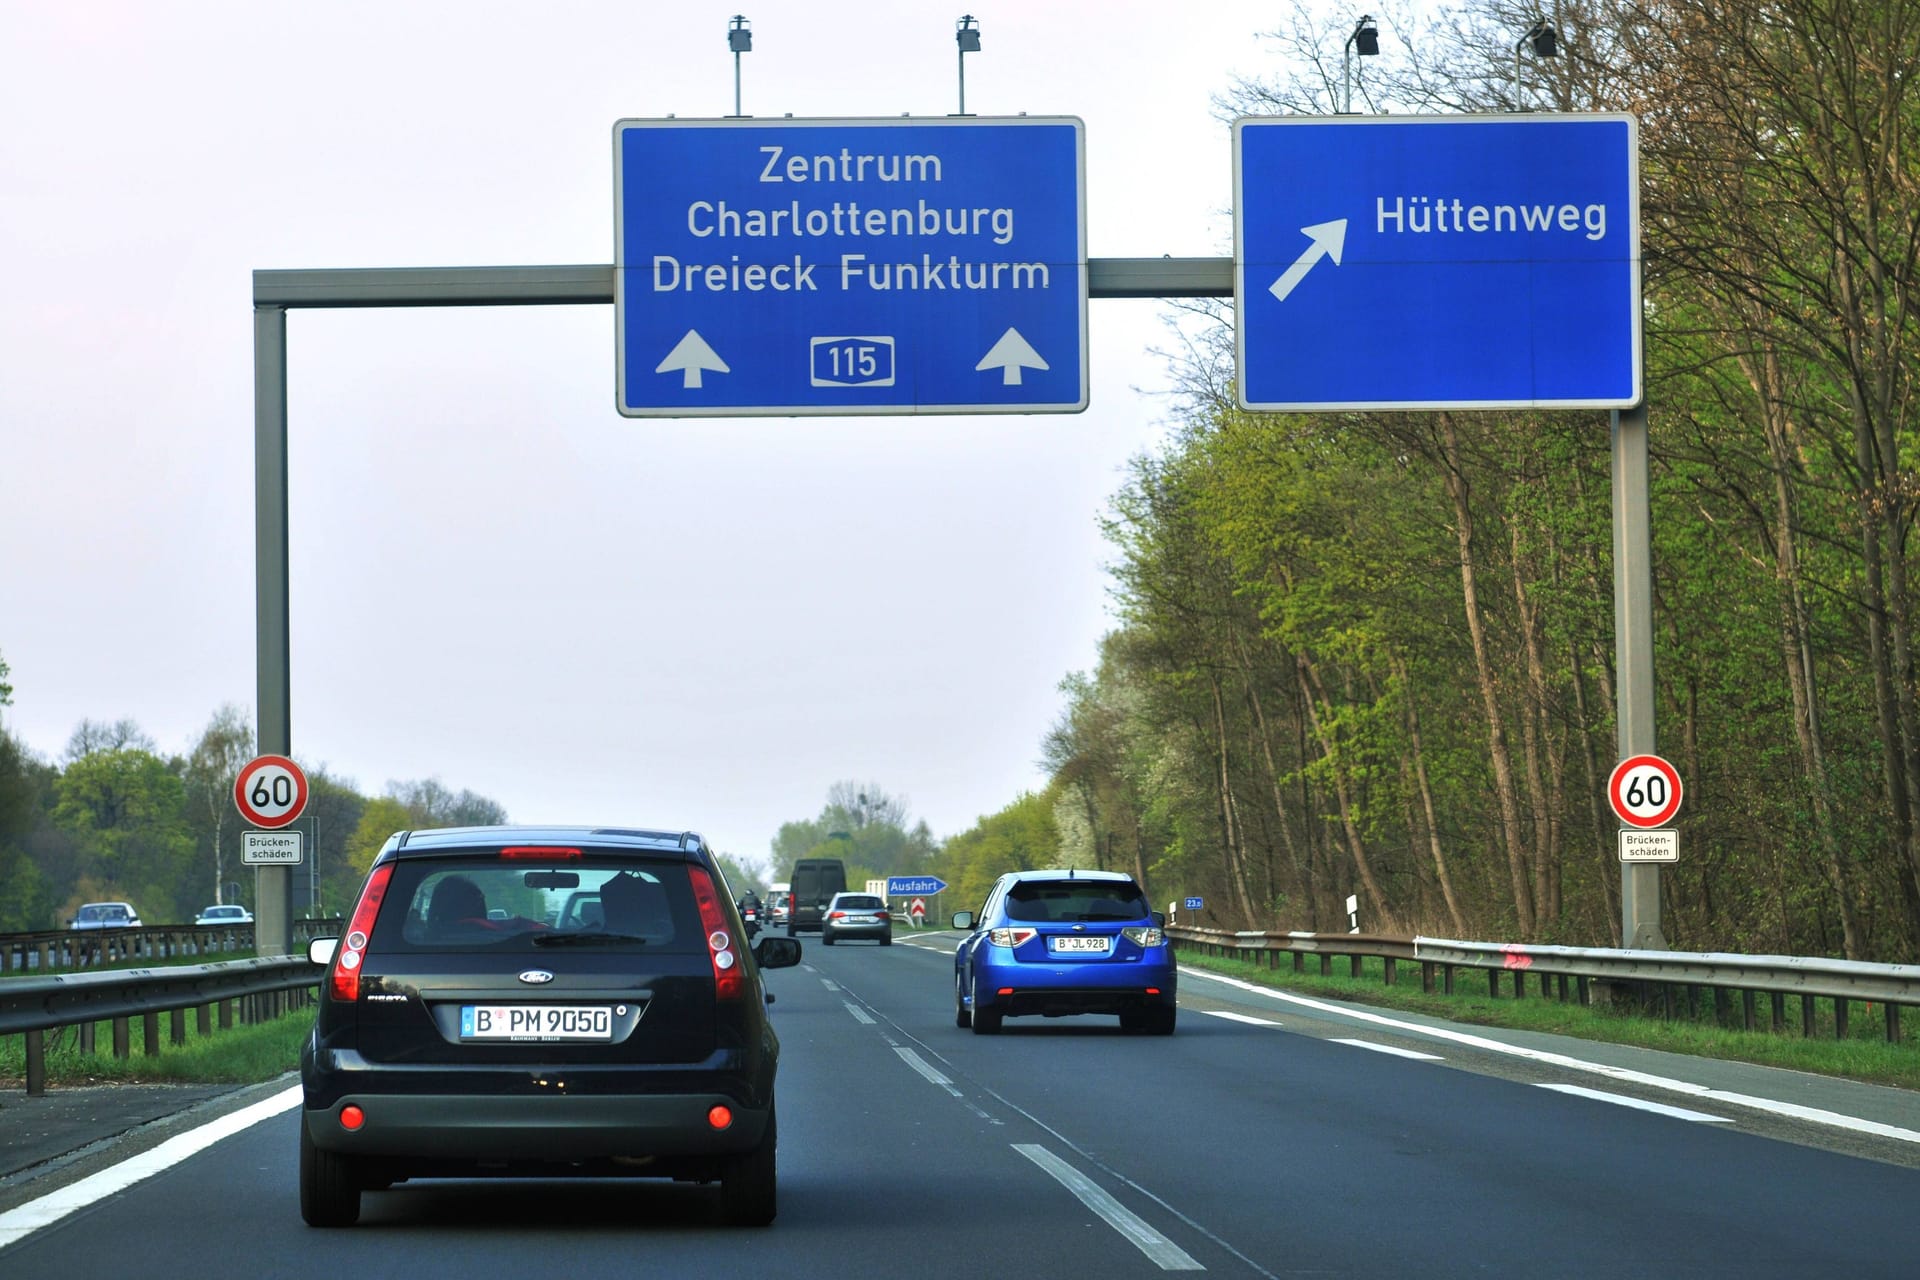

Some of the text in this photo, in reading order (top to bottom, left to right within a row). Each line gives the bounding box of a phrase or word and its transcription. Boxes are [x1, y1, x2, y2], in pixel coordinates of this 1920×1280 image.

[759, 146, 942, 183] Zentrum
[687, 199, 1014, 245] Charlottenburg
[1376, 196, 1606, 241] Hüttenweg
[653, 253, 1049, 292] Dreieck Funkturm
[828, 346, 877, 378] 115
[251, 775, 291, 808] 60
[1626, 775, 1666, 808] 60
[249, 837, 295, 847] Brücken-
[1626, 835, 1671, 845] Brücken-
[1629, 847, 1670, 857] schäden
[252, 849, 293, 859] schäden
[890, 880, 938, 892] Ausfahrt
[1059, 938, 1105, 949] B JL 928
[477, 1010, 608, 1032] B PM 9050
